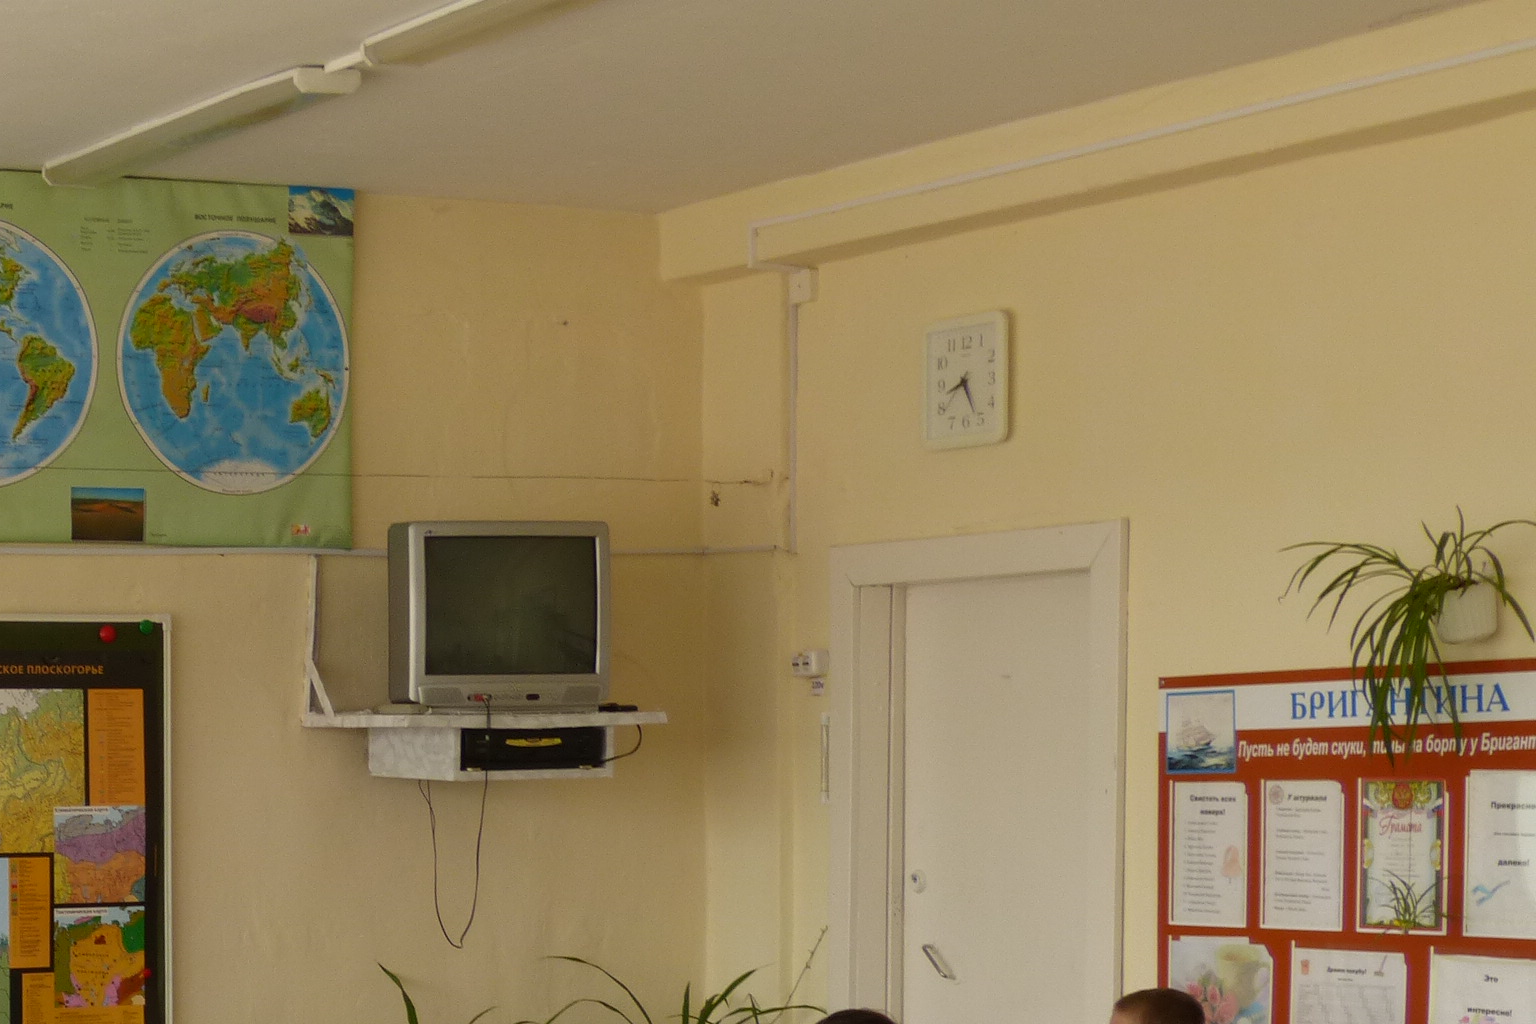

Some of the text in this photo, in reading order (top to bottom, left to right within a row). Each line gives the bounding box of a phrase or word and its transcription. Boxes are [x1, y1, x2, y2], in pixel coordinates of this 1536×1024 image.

[961, 335, 972, 349] 12
[937, 356, 948, 370] 10
[988, 349, 996, 363] 2
[988, 371, 996, 386] 3
[937, 380, 946, 393] 9
[937, 401, 946, 416] 8
[948, 415, 957, 430] 7
[961, 415, 970, 429] 6
[27, 663, 104, 675] ПЛОСКОГОРЬЕ
[1237, 740, 1274, 762] Пусть
[1276, 742, 1290, 756] не
[1292, 737, 1329, 760] будет
[1331, 740, 1366, 760] скуки,
[1379, 813, 1422, 839] Грамота
[1484, 974, 1499, 984] Это
[1467, 1006, 1513, 1018] интересно!
